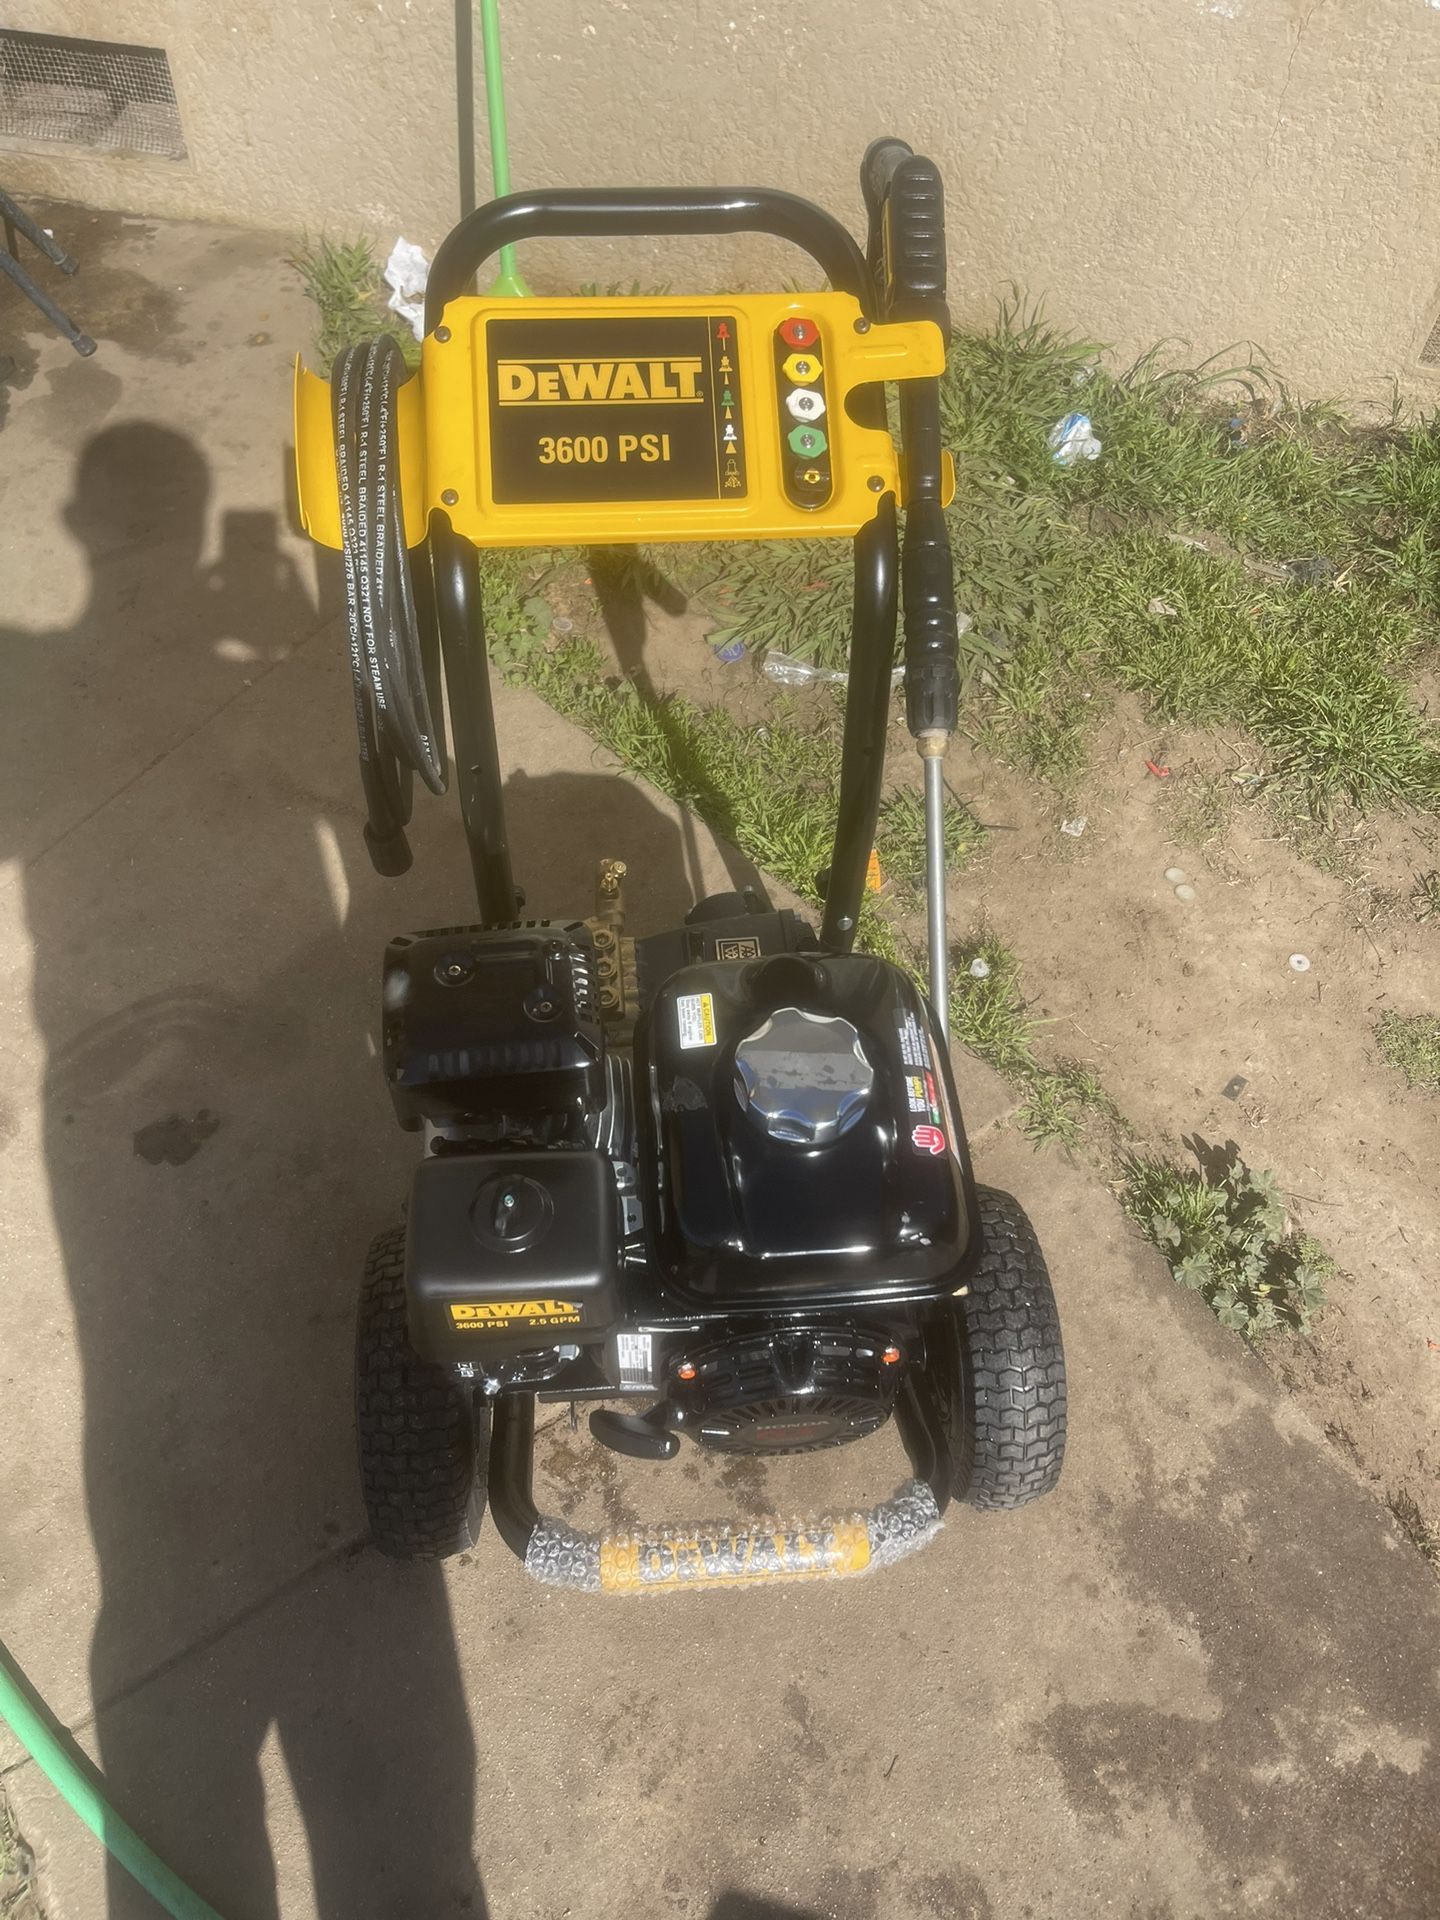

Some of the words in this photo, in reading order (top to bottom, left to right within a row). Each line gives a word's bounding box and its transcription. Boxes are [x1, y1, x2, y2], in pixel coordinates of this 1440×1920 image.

[498, 363, 701, 400] DEWALT
[359, 431, 368, 447] R-1
[538, 436, 608, 464] 3600
[619, 434, 671, 462] PSI
[339, 444, 349, 491] BRAIDED
[358, 449, 368, 484] STEEL
[378, 464, 386, 481] R-1
[358, 487, 367, 537] BRAIDED
[377, 485, 385, 520] STEEL
[359, 540, 368, 573] 41145
[375, 524, 385, 575] BRAIDED
[346, 582, 356, 605] BAR
[364, 606, 374, 632] NOT
[366, 632, 377, 654] FOR
[369, 656, 382, 690] STEAM
[704, 1008, 712, 1036] CAUTION
[455, 1321, 484, 1329] 3600
[487, 1320, 509, 1328] PSI
[529, 1318, 547, 1326] 2.5
[550, 1315, 581, 1324] GPM
